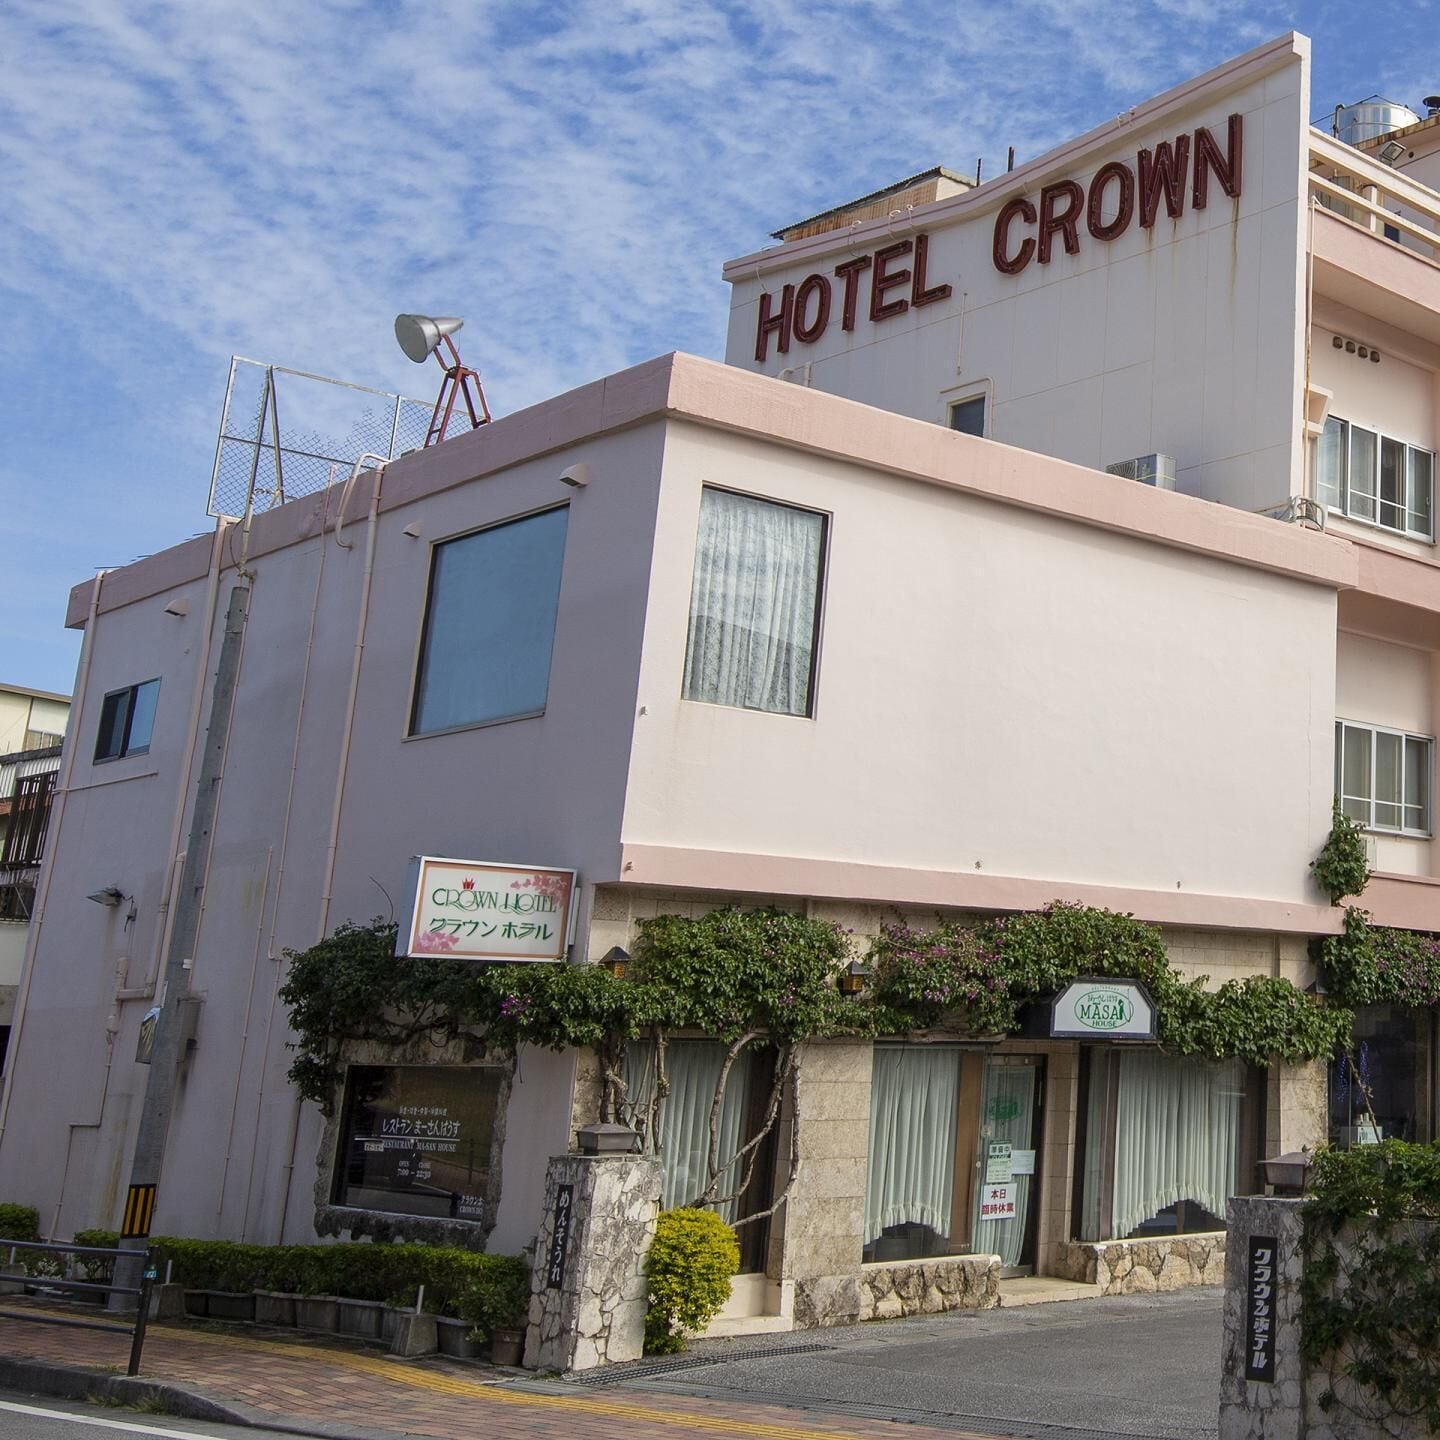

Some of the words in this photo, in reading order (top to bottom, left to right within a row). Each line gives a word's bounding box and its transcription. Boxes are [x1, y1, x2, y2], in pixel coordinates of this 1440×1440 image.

[754, 234, 952, 361] HOTEL
[993, 113, 1243, 275] CROWN
[432, 888, 499, 912] CROWN
[499, 892, 557, 915] HOTEL
[430, 918, 498, 937] クラウン
[501, 921, 553, 940] ホテル
[382, 1117, 413, 1134] レストラン
[991, 1189, 1006, 1200] 本日
[981, 1202, 1014, 1215] 臨時休業
[550, 1191, 571, 1283] めんそうれ
[1251, 1248, 1273, 1369] クラウンホテル
